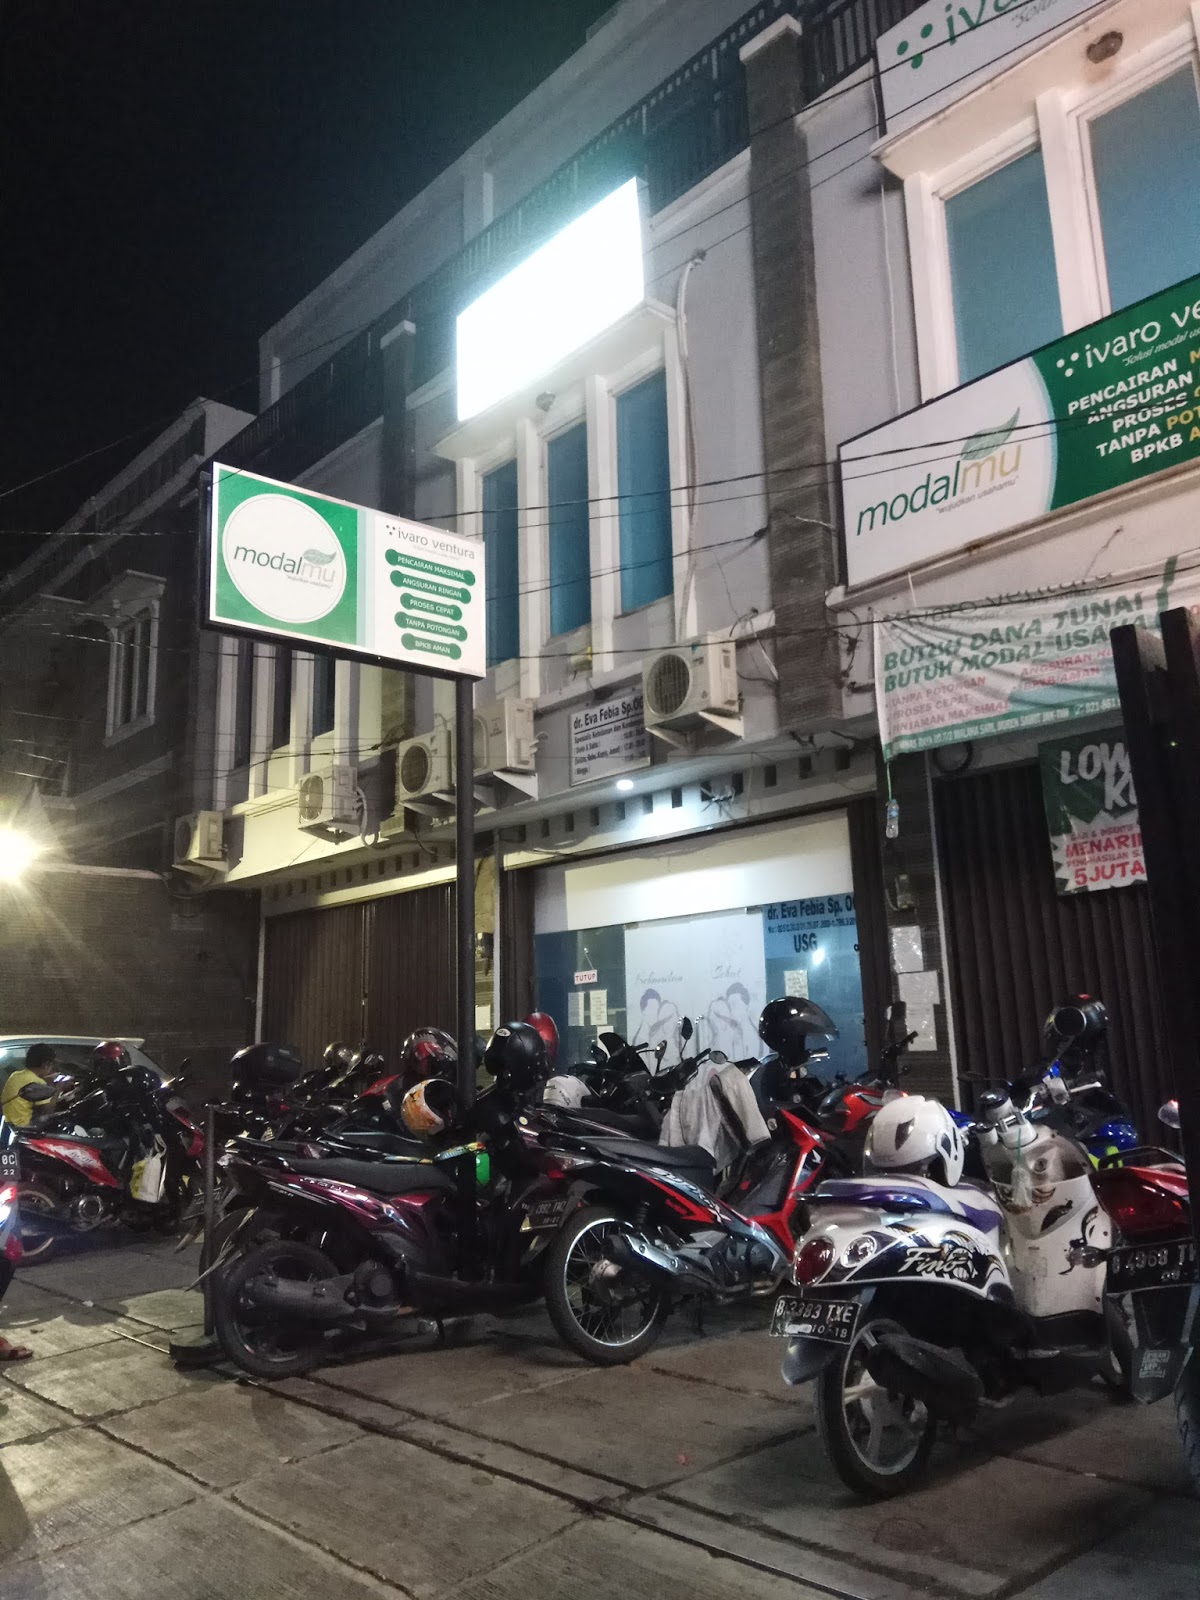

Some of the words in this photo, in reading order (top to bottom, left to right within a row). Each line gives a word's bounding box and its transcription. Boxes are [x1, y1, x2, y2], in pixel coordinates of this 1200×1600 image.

[1085, 321, 1160, 368] ivaro
[1068, 358, 1178, 415] PENCAIRAN
[1088, 371, 1193, 424] ANGSURAN
[1113, 392, 1188, 433] PROSES
[1096, 423, 1161, 457] TANPA
[1130, 433, 1183, 463] BPKB
[857, 445, 1021, 535] modalmu
[398, 528, 428, 545] ivaro
[432, 540, 475, 559] ventura
[234, 546, 335, 583] modalmu
[398, 556, 433, 571] PENCAIRAN
[434, 565, 465, 580] MAKSIMAL
[403, 578, 437, 592] ANGSURAN
[438, 586, 462, 598] RINGAN
[410, 599, 434, 611] PROSES
[436, 605, 454, 616] CEPAT
[970, 618, 1042, 651] DANA
[1054, 592, 1142, 629] TUNAI
[406, 618, 425, 628] TANPA
[427, 623, 460, 636] POTONGAN
[415, 640, 432, 649] BPKB
[433, 643, 450, 653] AMAN
[885, 660, 952, 693] BUTUH
[960, 641, 1045, 672] MODAL
[585, 713, 598, 726] Eva
[600, 705, 619, 721] Febia
[768, 904, 779, 920] dr.
[781, 903, 797, 919] Eva
[800, 899, 825, 917] Febia
[827, 897, 843, 917] Sp.
[793, 932, 817, 953] USG
[575, 972, 596, 983] TUTUP
[897, 1246, 960, 1273] Fino
[776, 1300, 785, 1317] B
